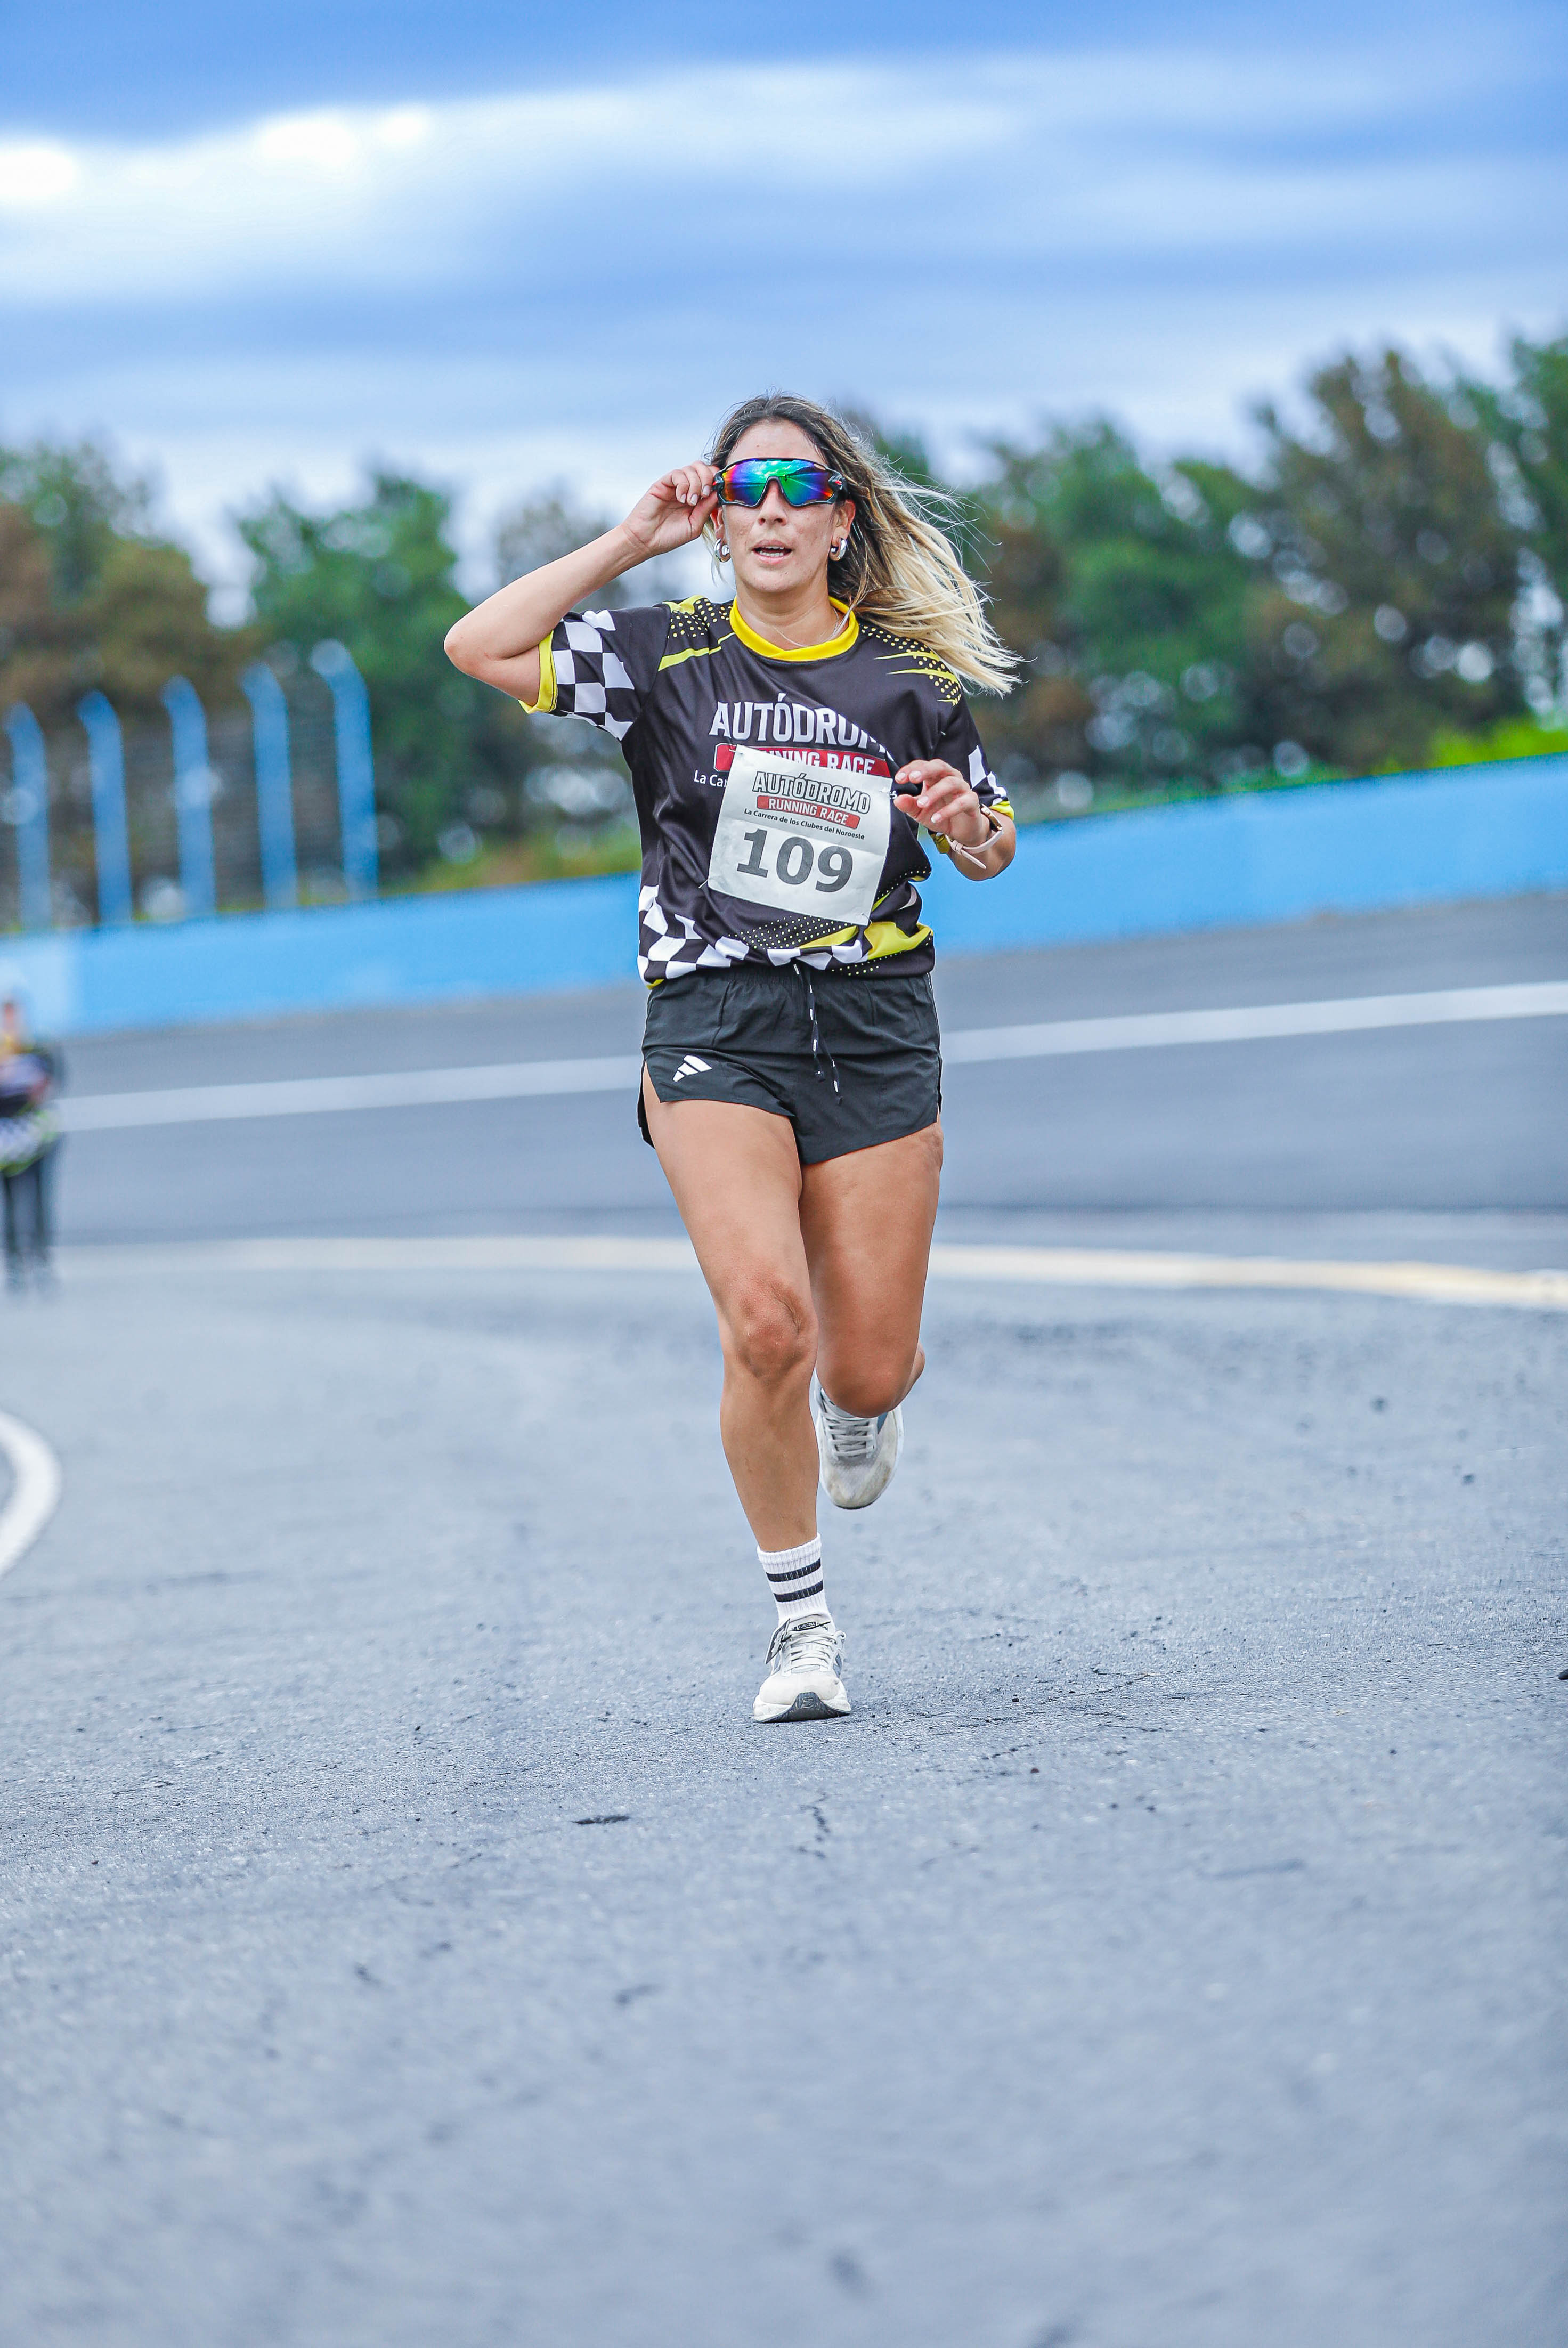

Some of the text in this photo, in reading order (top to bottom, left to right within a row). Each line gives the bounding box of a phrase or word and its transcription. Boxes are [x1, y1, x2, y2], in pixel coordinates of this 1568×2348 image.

[694, 770, 706, 784] La
[827, 753, 875, 774] RACE
[752, 771, 871, 814] AUTÓDROMO
[753, 810, 778, 820] Carrera
[801, 820, 823, 830] Clubes
[835, 828, 865, 840] Noroeste
[769, 798, 849, 825] RUNNING RACE
[737, 828, 853, 892] 109
